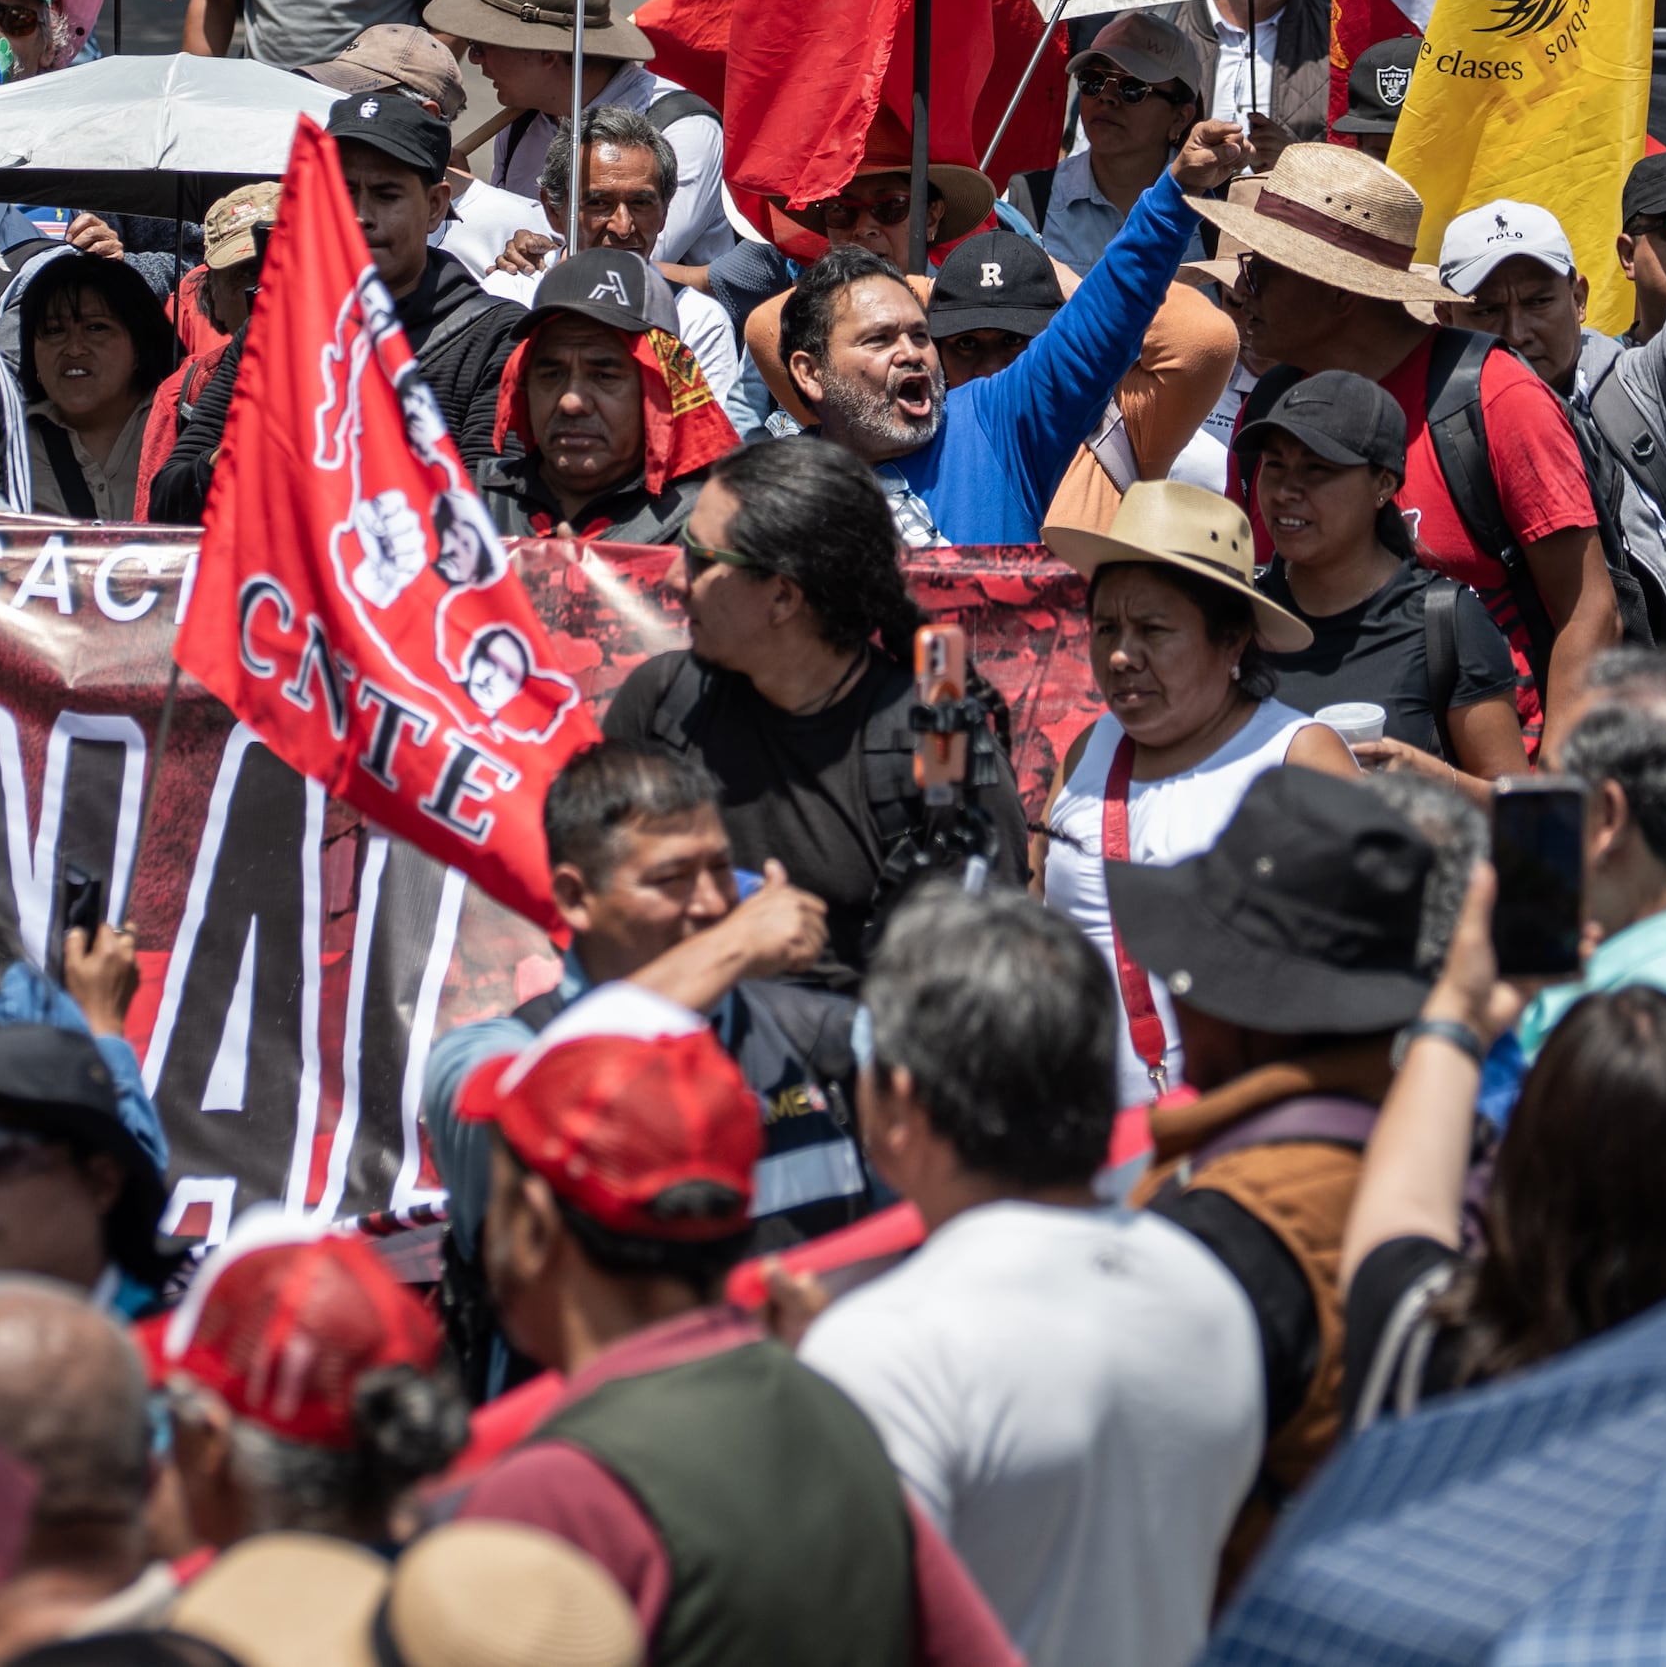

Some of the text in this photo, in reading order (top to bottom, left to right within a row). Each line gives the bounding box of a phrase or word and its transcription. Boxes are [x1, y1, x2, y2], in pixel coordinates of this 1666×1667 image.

[1435, 49, 1524, 80] clases
[1486, 231, 1524, 244] POLO
[980, 262, 1005, 288] R
[238, 573, 521, 846] CNTE
